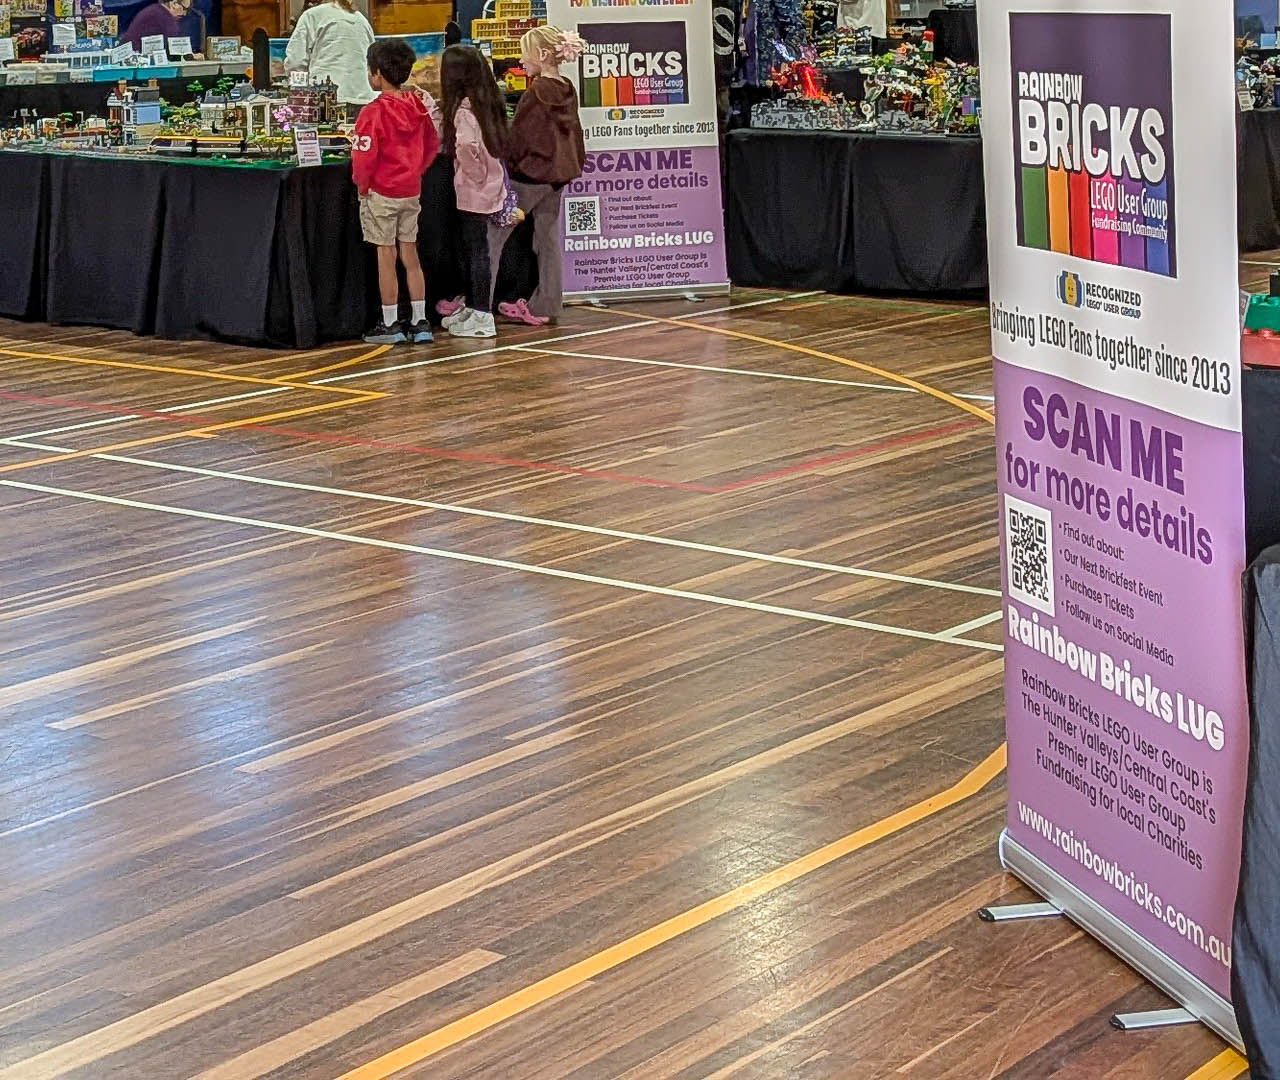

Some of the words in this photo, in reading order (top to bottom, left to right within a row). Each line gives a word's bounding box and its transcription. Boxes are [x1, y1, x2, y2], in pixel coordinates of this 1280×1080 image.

[584, 42, 630, 54] RAINBOW
[583, 51, 683, 78] BRICKS
[634, 77, 649, 88] LEGO
[665, 77, 684, 88] Group
[1019, 72, 1083, 105] RAINBOW
[351, 134, 372, 152] 23
[592, 127, 612, 138] LEGO
[613, 125, 632, 137] Fans
[634, 123, 670, 139] together
[672, 122, 694, 134] since
[696, 122, 715, 134] 2013
[1019, 99, 1166, 184] BRICKS
[584, 151, 652, 174] SCAN
[656, 149, 693, 170] ME
[568, 179, 592, 194] for
[596, 179, 644, 192] more
[647, 171, 709, 190] details
[1091, 180, 1115, 211] LEGO
[1117, 183, 1140, 217] User
[1141, 187, 1168, 222] Group
[565, 236, 632, 252] Rainbow
[634, 232, 683, 248] Bricks
[685, 231, 714, 245] LUG
[1091, 212, 1131, 237] Fundraising
[1132, 219, 1168, 244] Community
[575, 258, 608, 267] Rainbow
[635, 255, 655, 263] LEGO
[656, 254, 674, 262] User
[675, 253, 699, 262] Group
[575, 268, 588, 276] The
[590, 266, 616, 275] Hunter
[594, 275, 624, 284] Premier
[666, 271, 690, 281] Group
[1086, 282, 1141, 307] RECOGNIZED
[1103, 302, 1119, 315] USER
[1120, 306, 1141, 319] GROUP
[992, 301, 1035, 347] Bringing
[1039, 313, 1066, 348] LEGO
[1069, 322, 1093, 357] Fans
[1095, 329, 1152, 372] together
[1154, 348, 1188, 384] since
[1191, 355, 1232, 395] 2013
[1023, 385, 1123, 472] SCAN
[1130, 419, 1185, 496] ME
[1005, 441, 1040, 493] for
[1045, 465, 1111, 522] more
[1116, 487, 1213, 565] details
[1063, 522, 1081, 542] Find
[1081, 529, 1095, 548] out
[1063, 549, 1078, 565] Our
[1079, 554, 1098, 573] Next
[1099, 561, 1138, 595] Brickfest
[1138, 583, 1164, 606] Event
[1064, 575, 1102, 604] Purchase
[1104, 589, 1135, 620] Tickets
[1065, 601, 1091, 625] Follow
[1092, 617, 1103, 631] us
[1104, 622, 1116, 637] on
[1117, 623, 1144, 652] Social
[1146, 640, 1175, 667] Media
[1008, 604, 1097, 682] Rainbow
[1099, 651, 1174, 724] Bricks
[1176, 692, 1225, 751] LUG
[1022, 669, 1066, 707] Rainbow
[1068, 693, 1100, 728] Bricks
[1102, 718, 1131, 745] LEGO
[1133, 731, 1159, 763] User
[1161, 748, 1200, 790] Group
[1202, 775, 1214, 795] is
[1021, 691, 1041, 716] The
[1043, 702, 1078, 737] Hunter
[1080, 724, 1167, 795] Valleys/Central
[1170, 782, 1216, 825] Coast's
[1048, 731, 1088, 771] Premier
[1090, 756, 1118, 789] LEGO
[1120, 775, 1146, 805] User
[1148, 794, 1186, 833] Group
[1036, 747, 1097, 808] Fundraising
[1099, 787, 1115, 811] for
[1116, 796, 1145, 834] local
[1147, 820, 1203, 870] Charities
[1018, 800, 1232, 970] www.rainbowbricks.com.au
